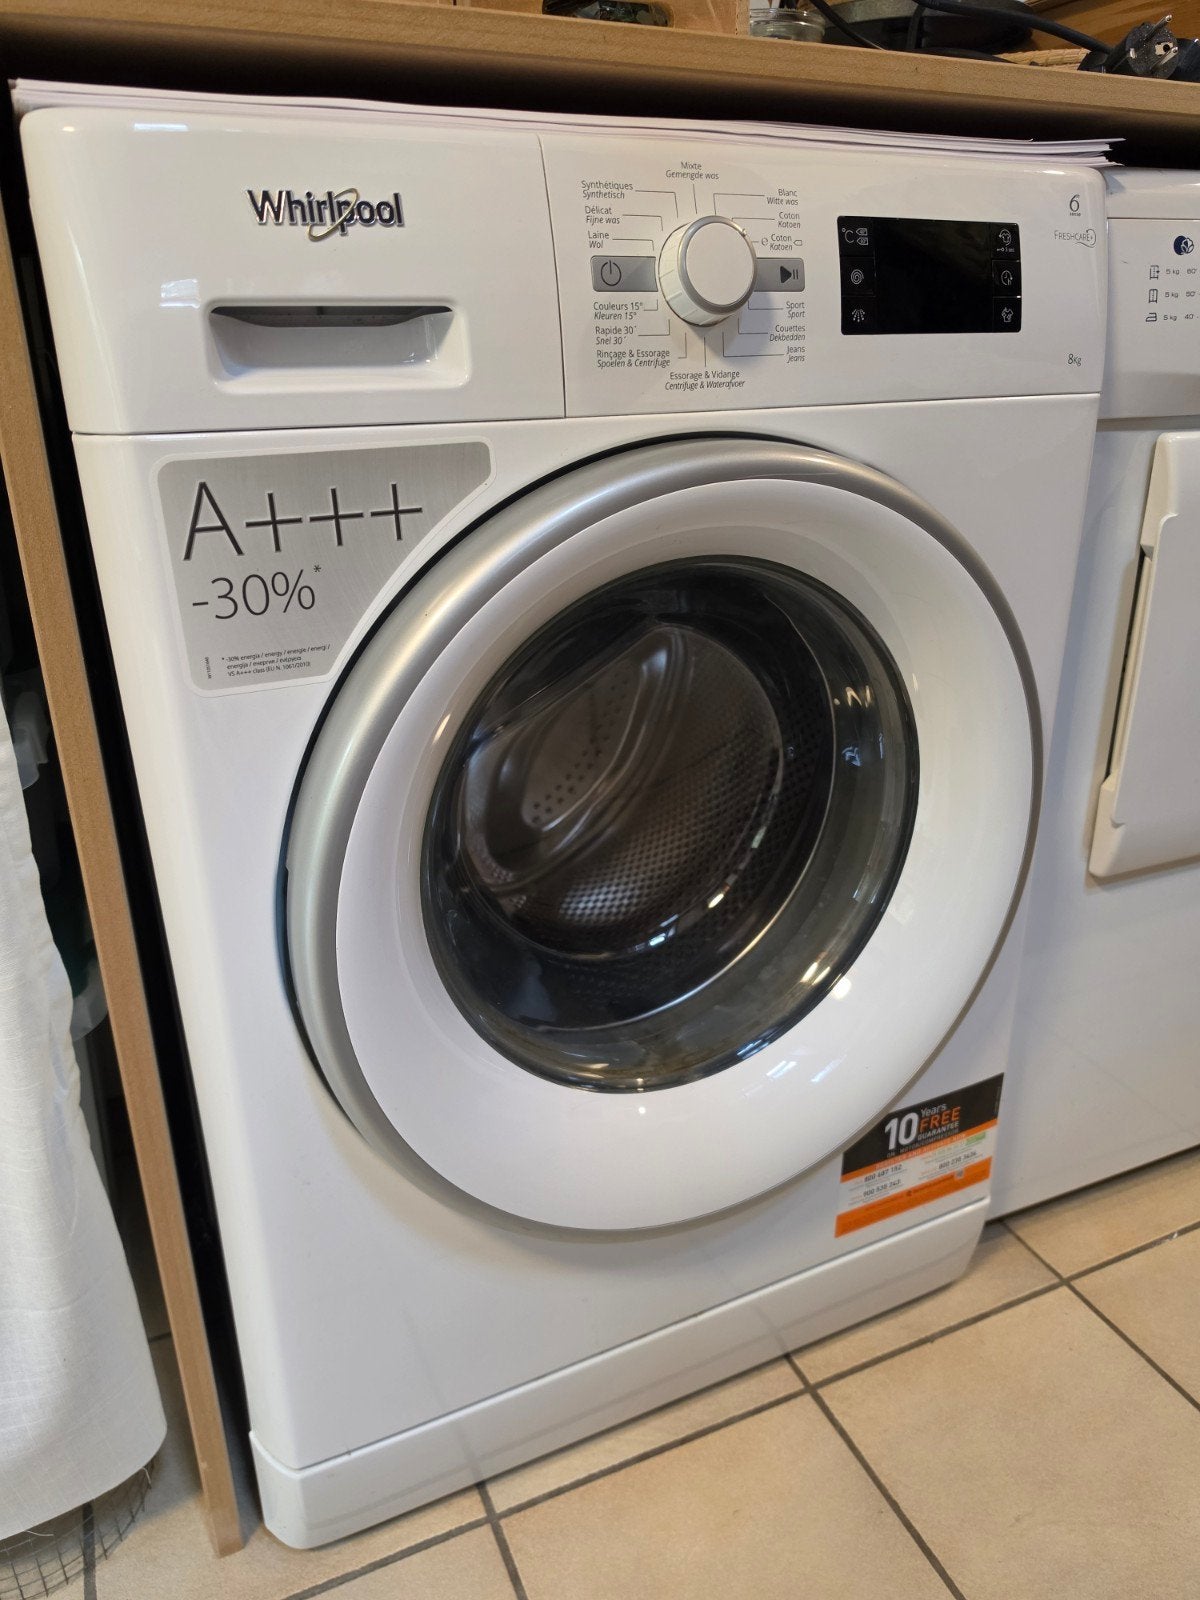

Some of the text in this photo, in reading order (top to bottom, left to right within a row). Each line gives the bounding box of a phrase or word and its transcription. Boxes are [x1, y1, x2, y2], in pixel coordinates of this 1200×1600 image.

[680, 161, 702, 170] Mixte
[665, 169, 704, 181] Gemengde
[581, 180, 634, 191] Synthétiques
[582, 189, 625, 200] Synthetisch
[778, 188, 798, 197] Blanc
[766, 197, 799, 206] Witte was
[247, 188, 405, 236] Whirlpool
[584, 205, 612, 215] Délicat
[585, 215, 620, 226] Fijne was
[778, 211, 800, 220] Coton
[777, 220, 801, 229] Katoen
[587, 230, 610, 240] Laine
[770, 233, 792, 243] Coton
[588, 240, 604, 249] Wol
[769, 243, 793, 251] Katoen
[593, 301, 643, 311] Couleurs 15°
[786, 301, 806, 311] Sport
[593, 311, 637, 321] Kleuren 15°
[787, 310, 806, 320] Sport
[595, 326, 622, 337] Rapide
[775, 325, 806, 333] Couettes
[595, 336, 612, 345] Snel
[769, 333, 806, 342] Dekbedden
[596, 349, 671, 361] Rinçage & Essorage
[786, 345, 806, 355] Jeans
[597, 358, 671, 369] Spoelen & Centrifuge
[786, 354, 806, 364] Jeans
[669, 370, 740, 382] Essorage & Vidange
[664, 380, 746, 392] Centrifuge & Waterafvoer
[183, 481, 423, 561] A+++
[920, 1106, 961, 1133] FREE
[884, 1112, 919, 1151] 10
[920, 1103, 948, 1118] Years
[916, 1121, 960, 1141] GUARANTEE
